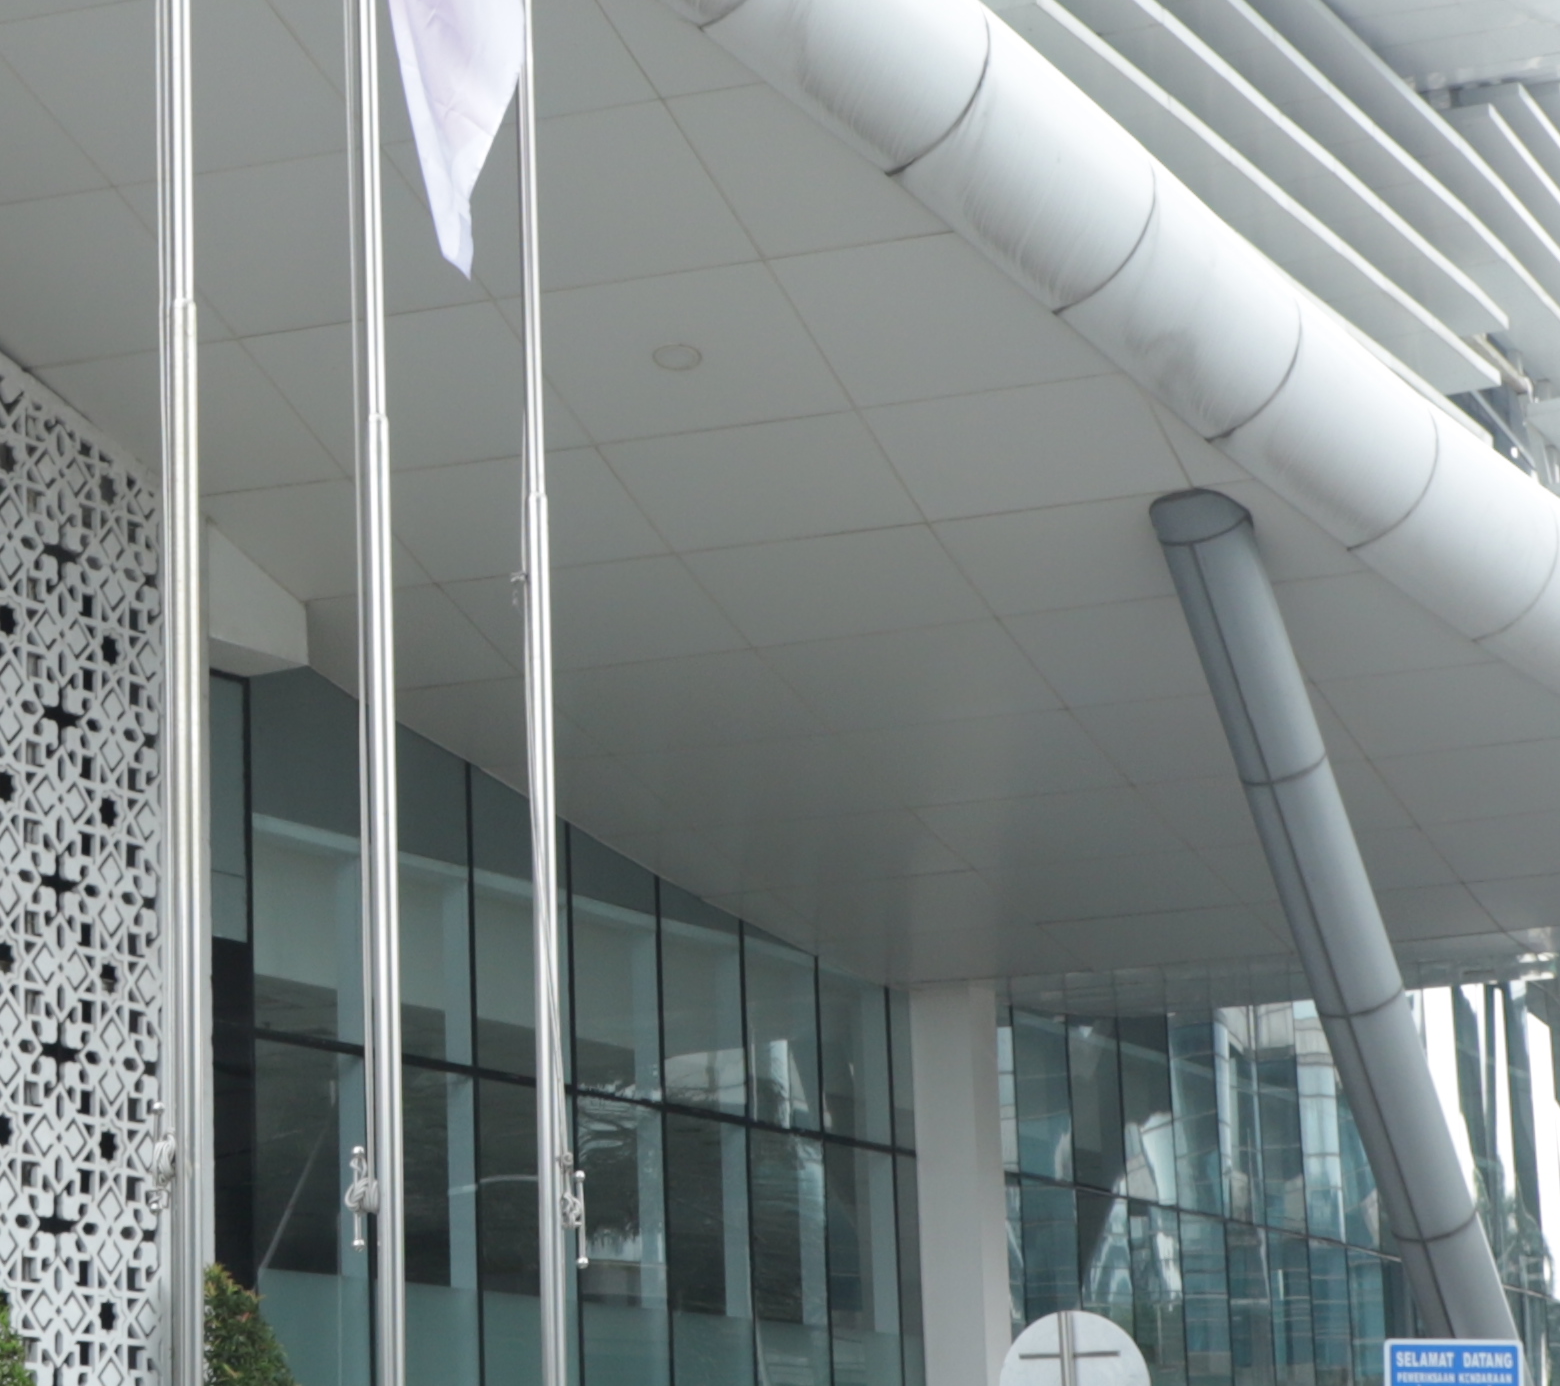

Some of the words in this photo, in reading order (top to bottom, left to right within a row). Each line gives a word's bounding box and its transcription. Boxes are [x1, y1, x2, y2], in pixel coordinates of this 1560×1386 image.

[1396, 1351, 1455, 1368] SELAMAT
[1462, 1352, 1514, 1369] DATANG
[1458, 1373, 1513, 1384] KENDARAAN
